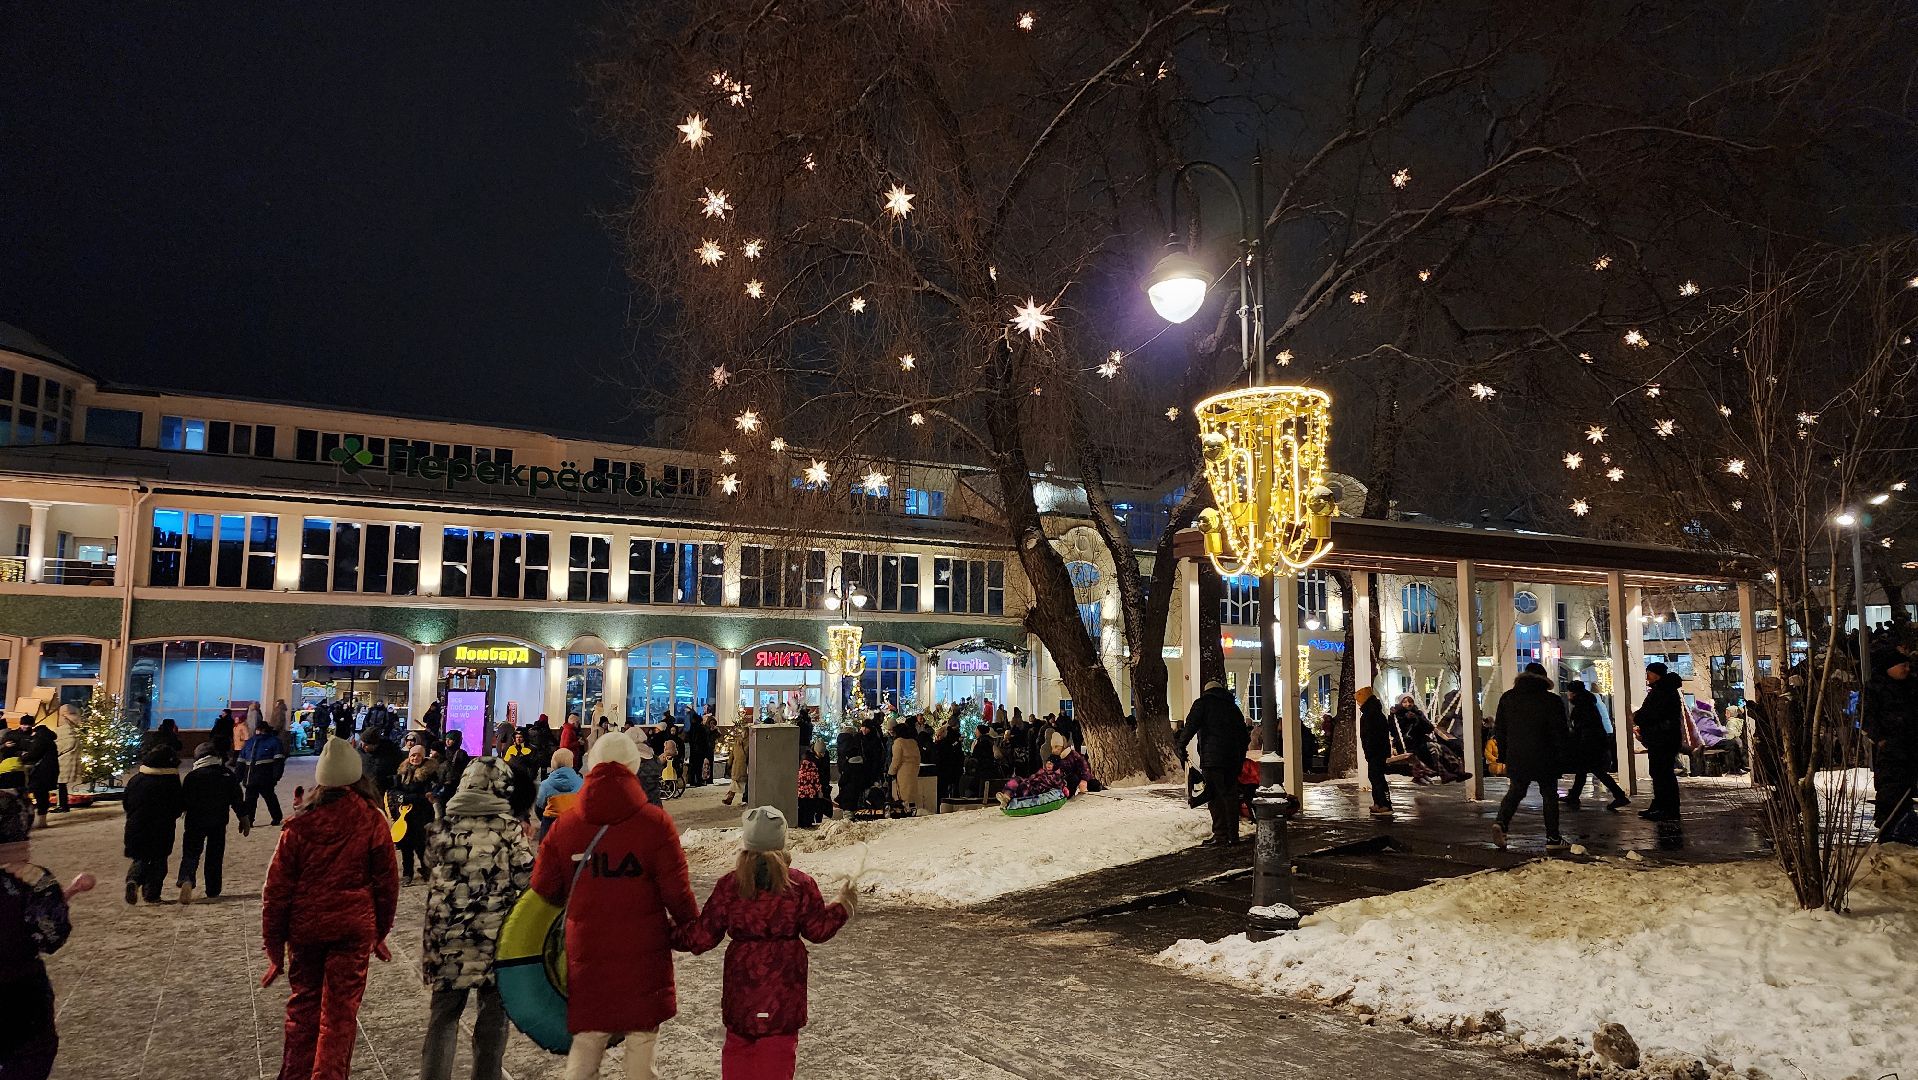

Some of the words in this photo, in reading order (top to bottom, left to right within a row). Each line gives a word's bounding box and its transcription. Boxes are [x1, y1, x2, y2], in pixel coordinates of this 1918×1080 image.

[387, 444, 666, 498] Перекрёсток
[756, 651, 812, 667] ЯНИТА
[946, 657, 990, 671] familia
